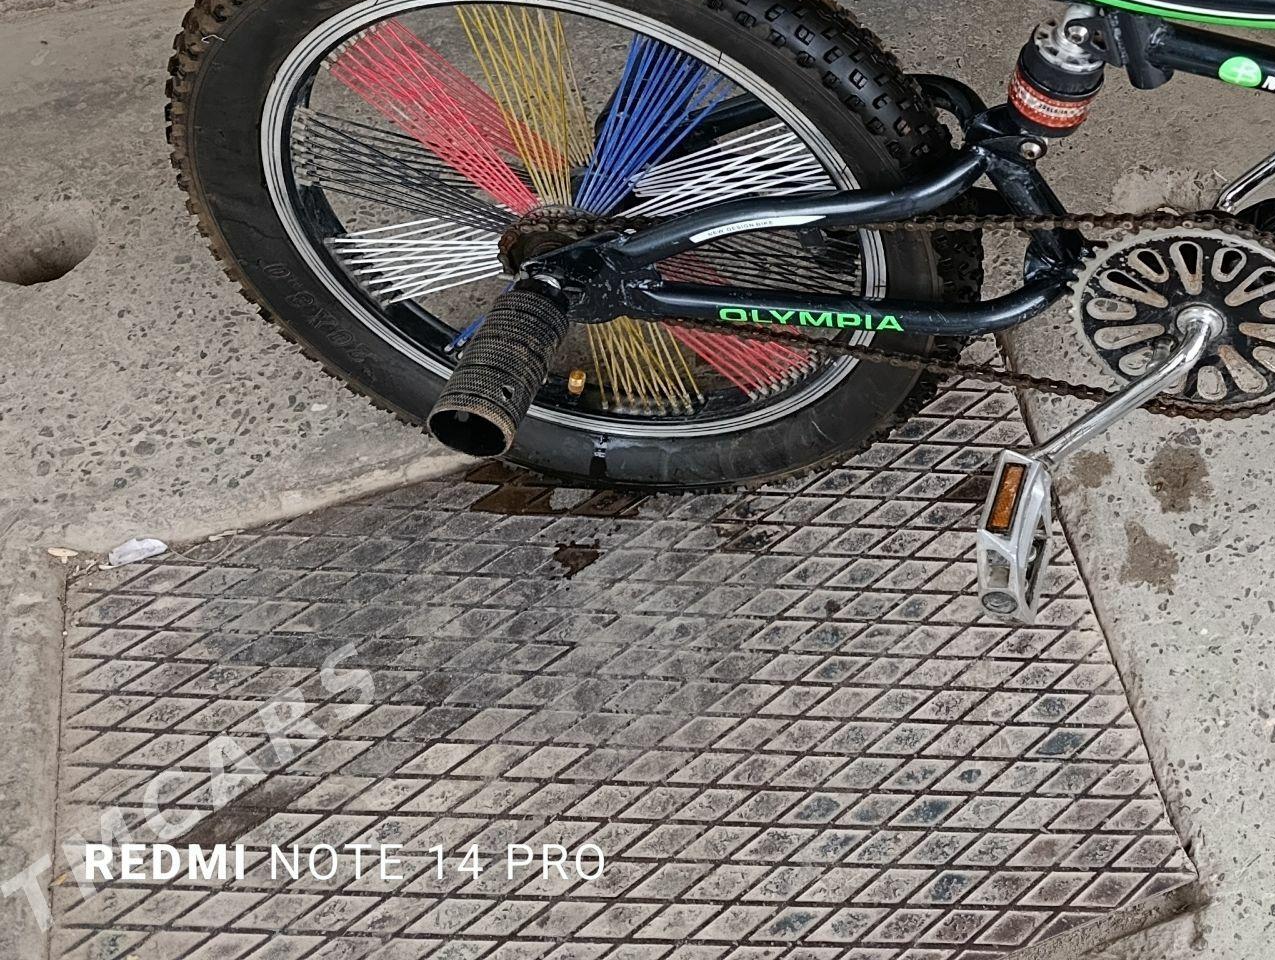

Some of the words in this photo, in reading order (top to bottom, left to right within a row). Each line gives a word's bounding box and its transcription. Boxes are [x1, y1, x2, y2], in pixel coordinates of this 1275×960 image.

[707, 228, 725, 236] NEW
[727, 222, 755, 233] DESIGN
[719, 308, 904, 332] OLYMPIA
